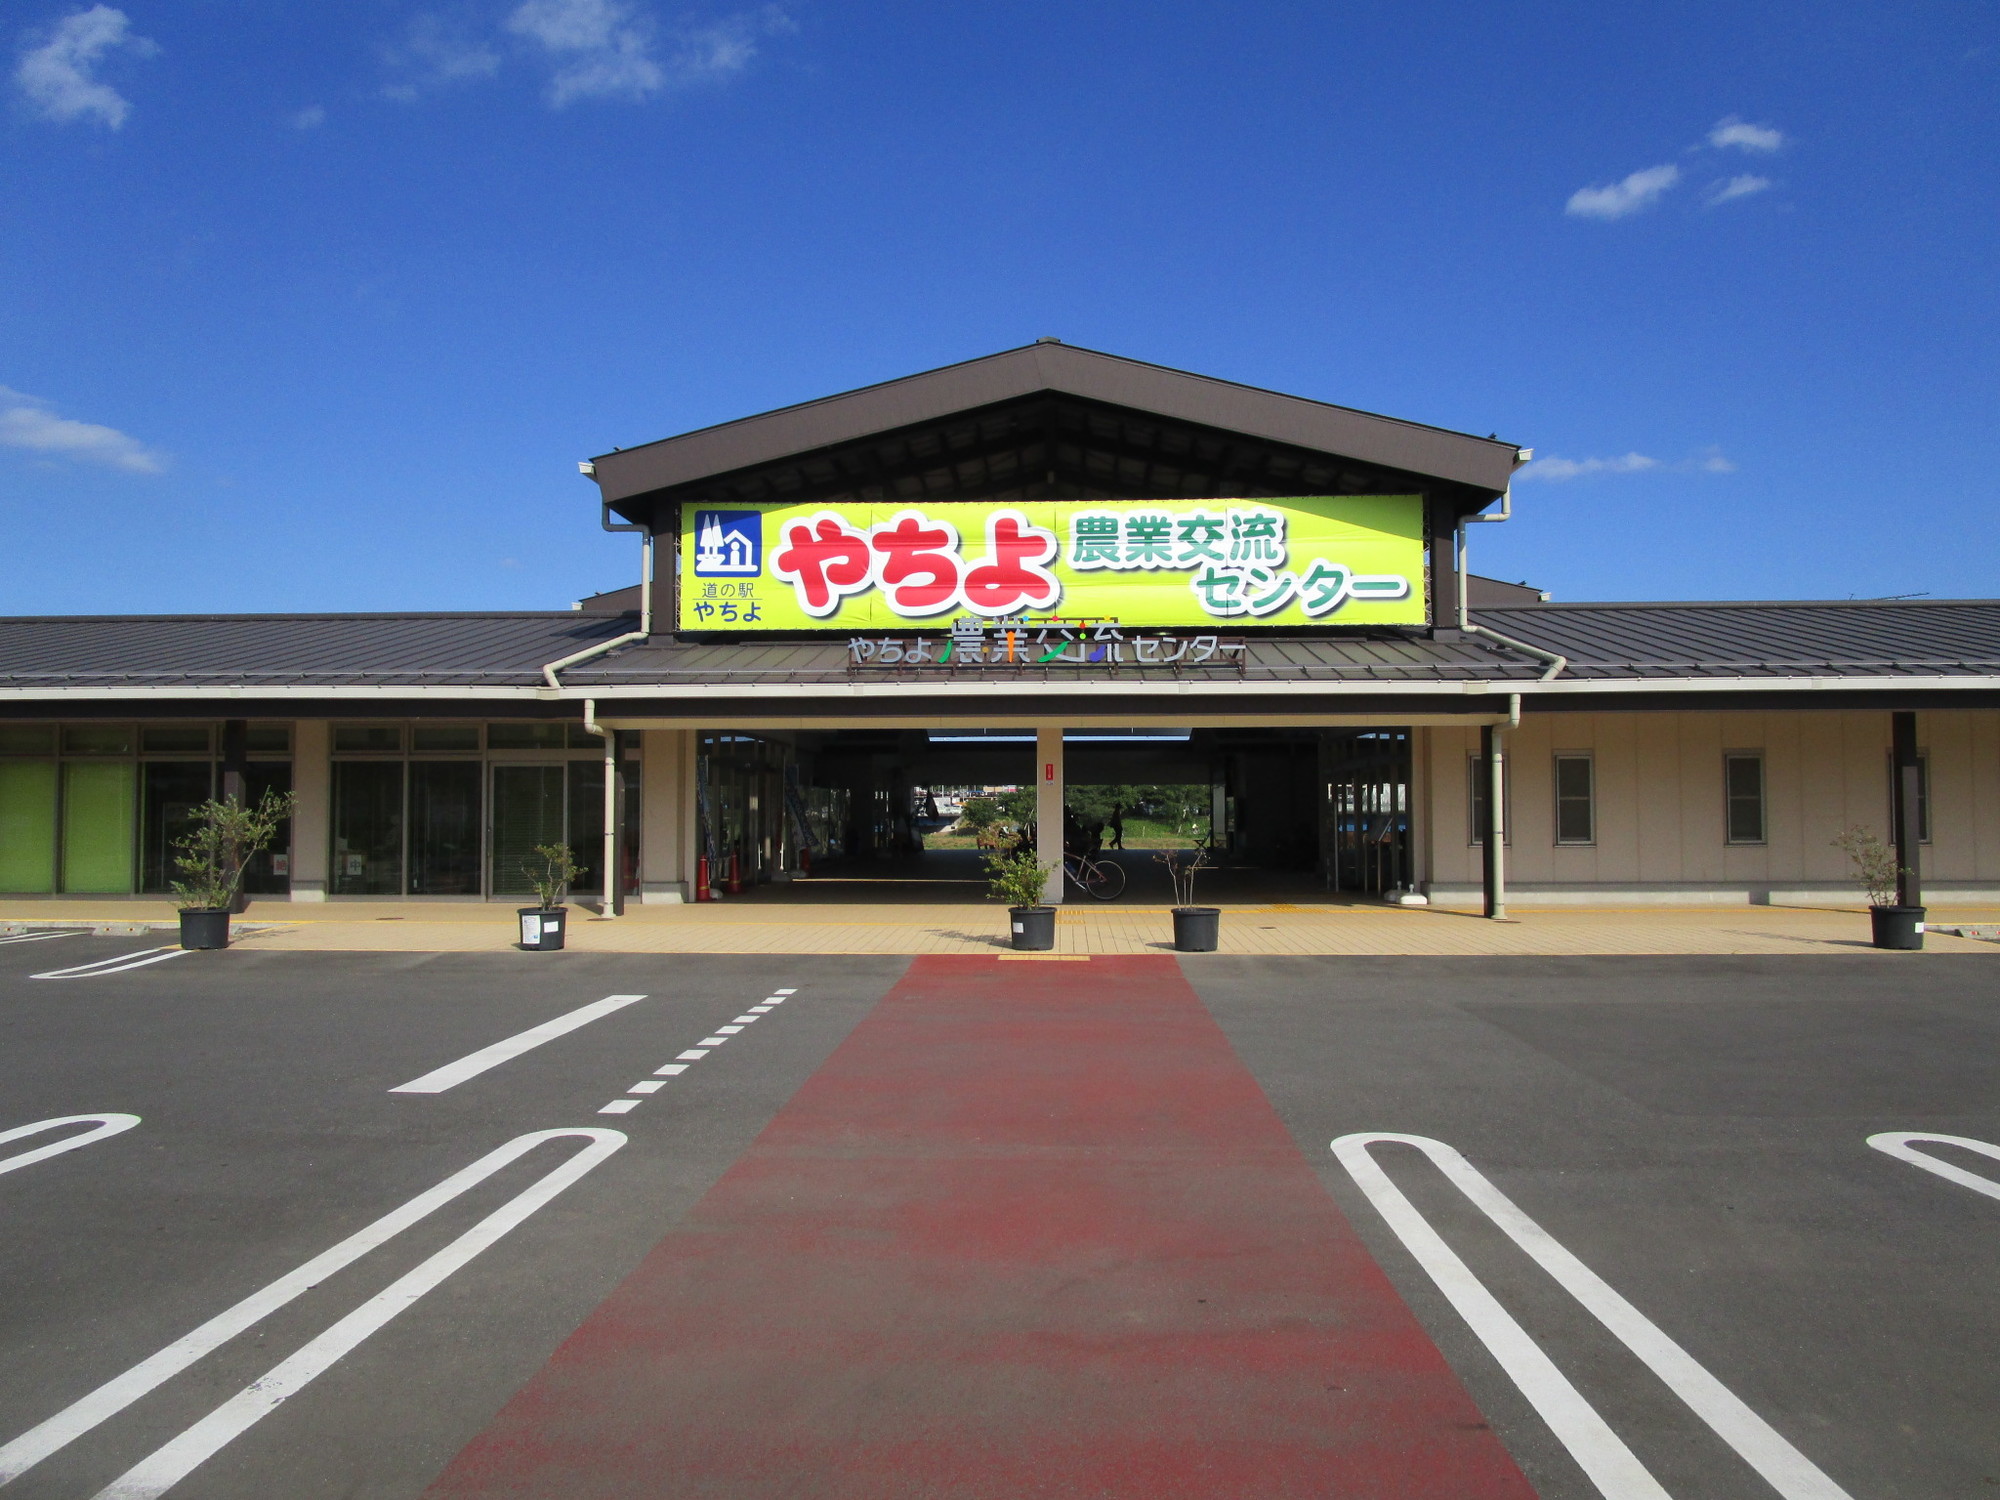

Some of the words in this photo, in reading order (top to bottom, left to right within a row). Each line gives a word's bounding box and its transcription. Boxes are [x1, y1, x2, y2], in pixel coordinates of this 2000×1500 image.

[1073, 513, 1278, 562] 農業交流
[777, 517, 1051, 608] やちよ
[701, 582, 755, 598] 道の駅
[1196, 564, 1401, 609] センター
[693, 600, 762, 622] やちよ
